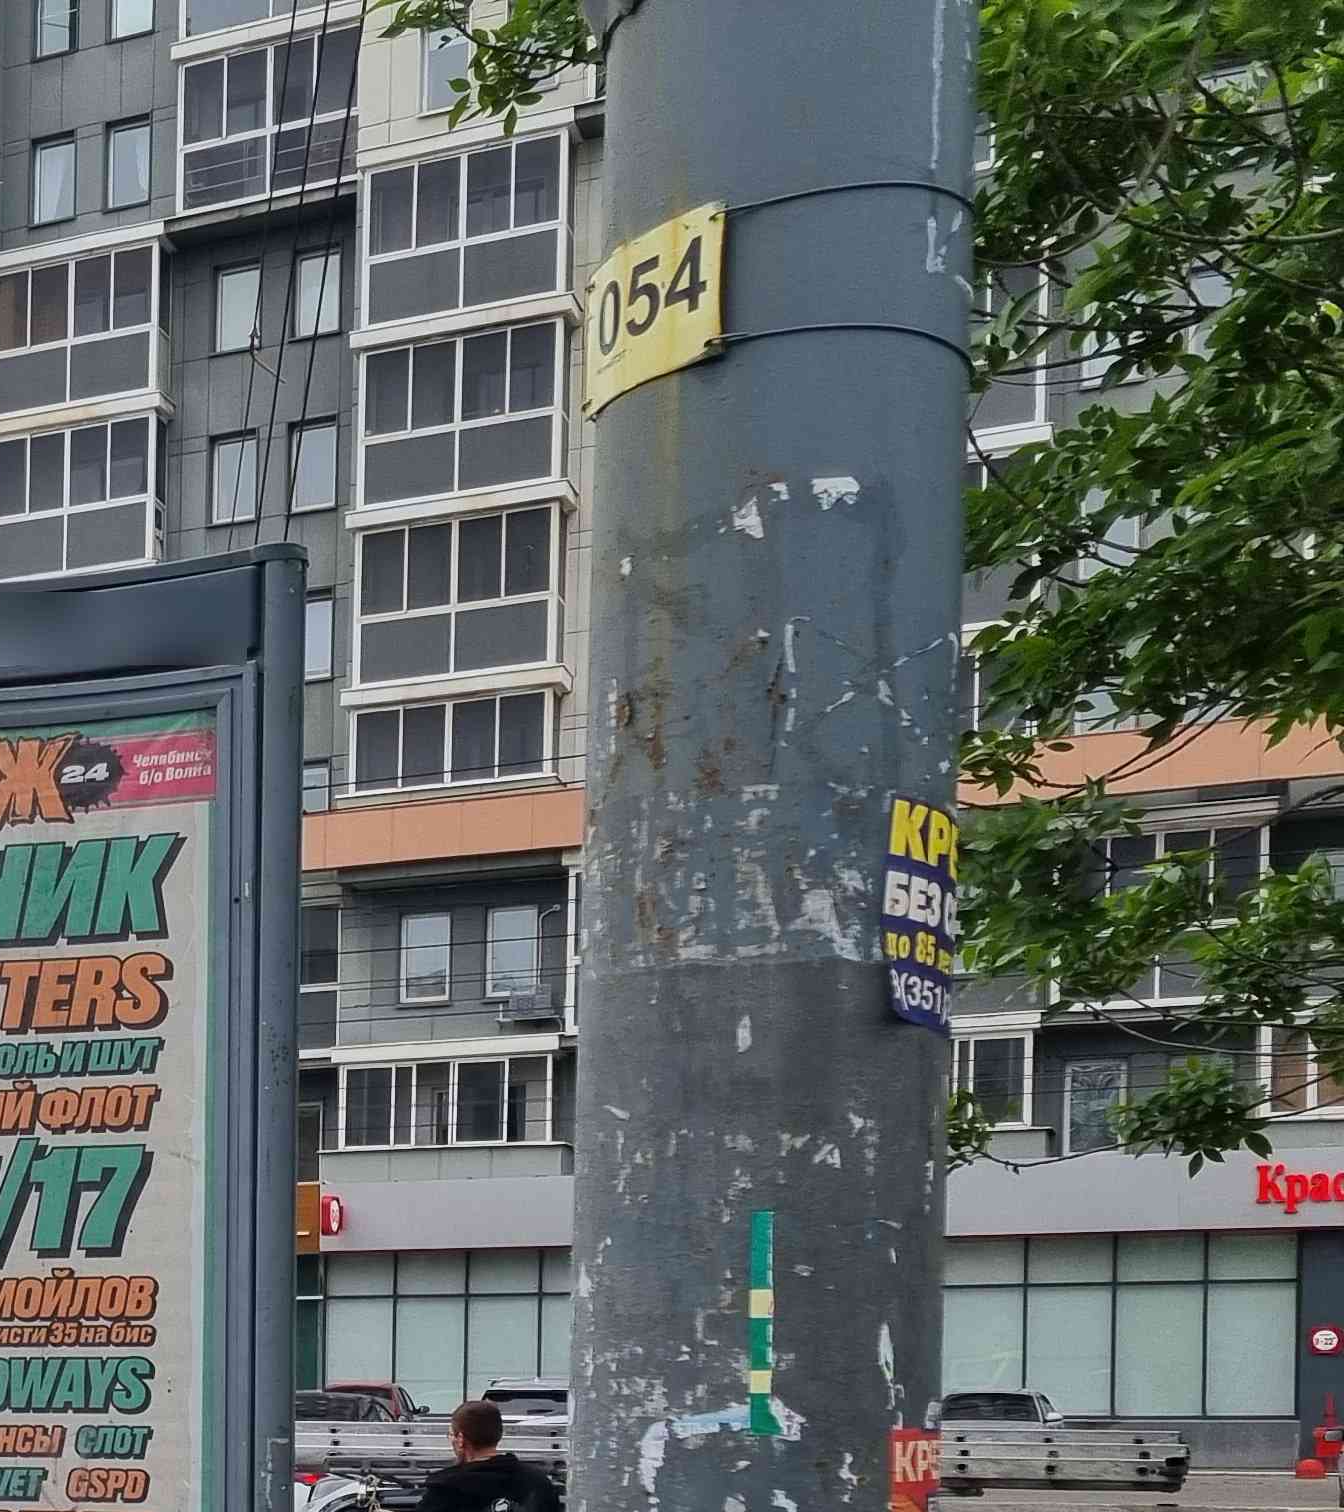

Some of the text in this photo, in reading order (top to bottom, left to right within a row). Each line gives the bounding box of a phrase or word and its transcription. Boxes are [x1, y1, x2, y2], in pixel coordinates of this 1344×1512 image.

[599, 235, 707, 356] 054
[61, 762, 109, 784] 24
[165, 763, 211, 781] Волна
[882, 870, 942, 928] БЕЗ
[60, 1041, 86, 1074] И
[87, 1037, 164, 1076] ШУТ
[38, 1084, 159, 1135] ФЛОТ
[48, 1322, 79, 1346] 35
[80, 1326, 111, 1346] на
[111, 1322, 156, 1346] бис
[75, 1425, 153, 1459] СЛОТ
[66, 1468, 150, 1502] GSPD
